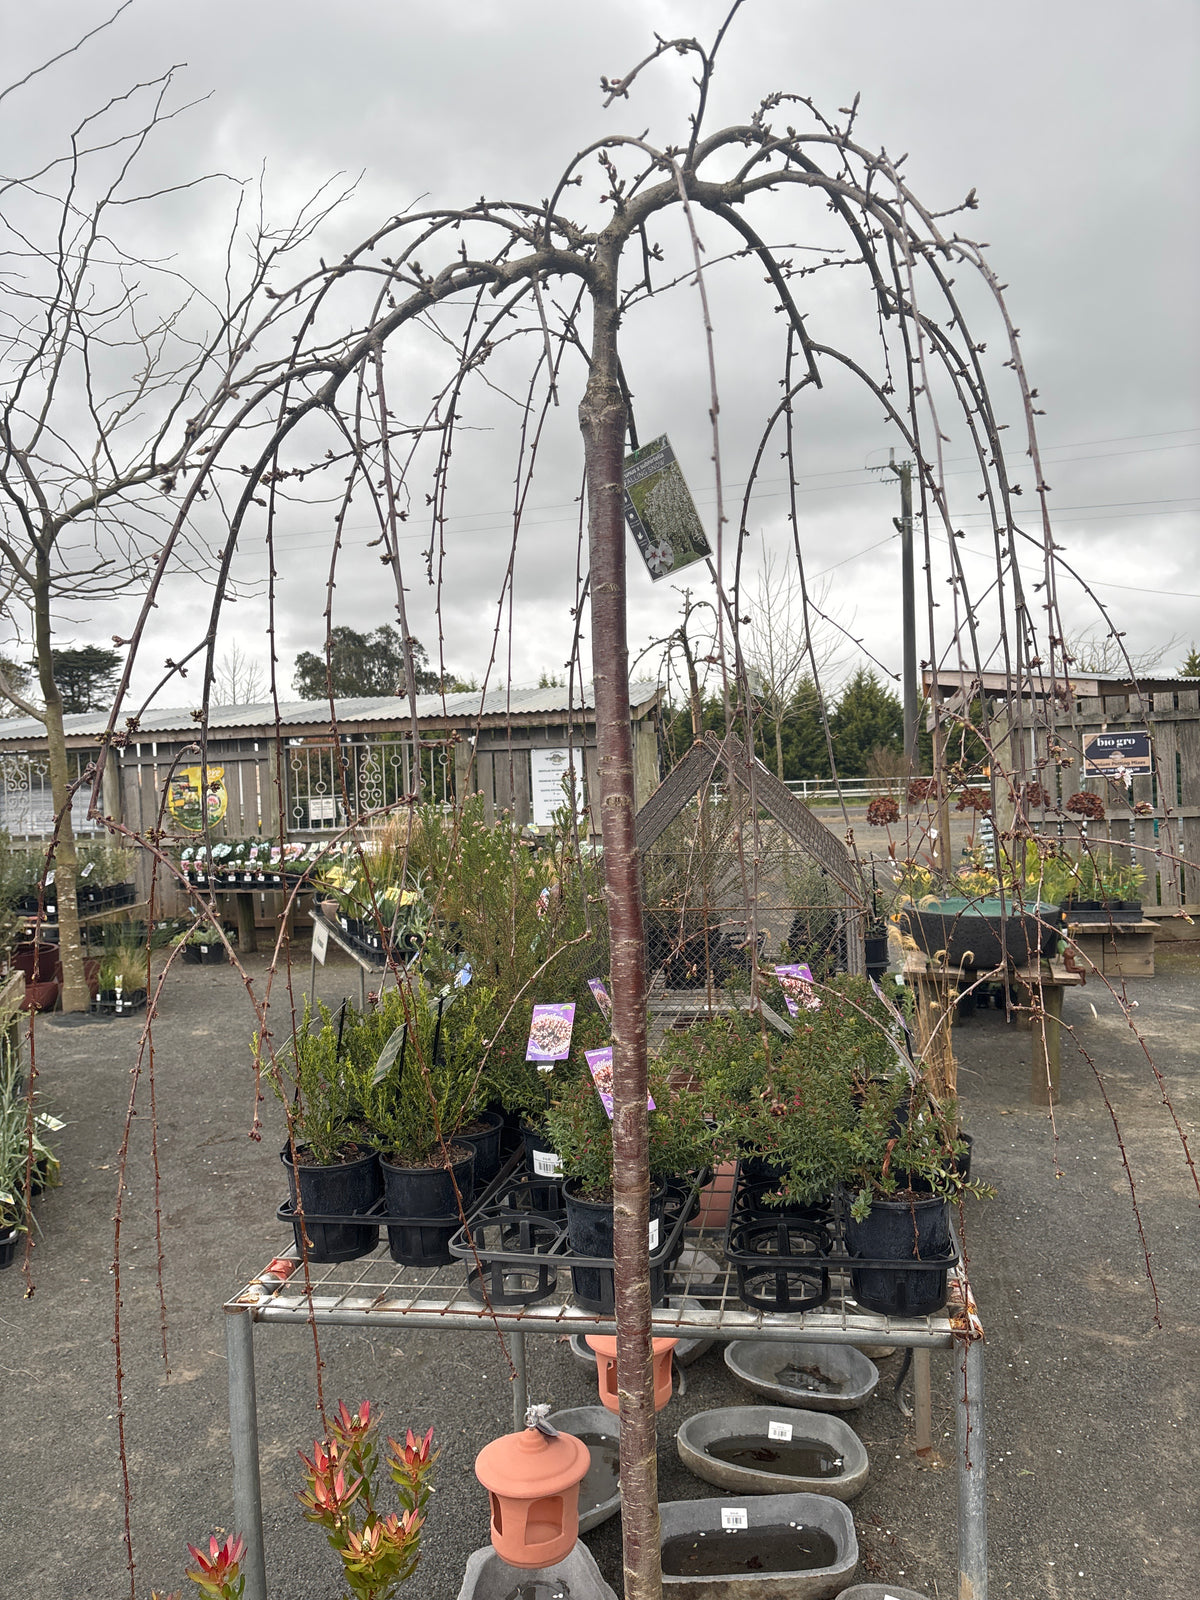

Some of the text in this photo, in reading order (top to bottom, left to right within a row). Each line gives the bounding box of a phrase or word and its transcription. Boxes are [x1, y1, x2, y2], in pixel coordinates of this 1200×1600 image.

[648, 459, 666, 473] SNOW
[1097, 737, 1115, 746] bio
[1116, 738, 1136, 748] gro
